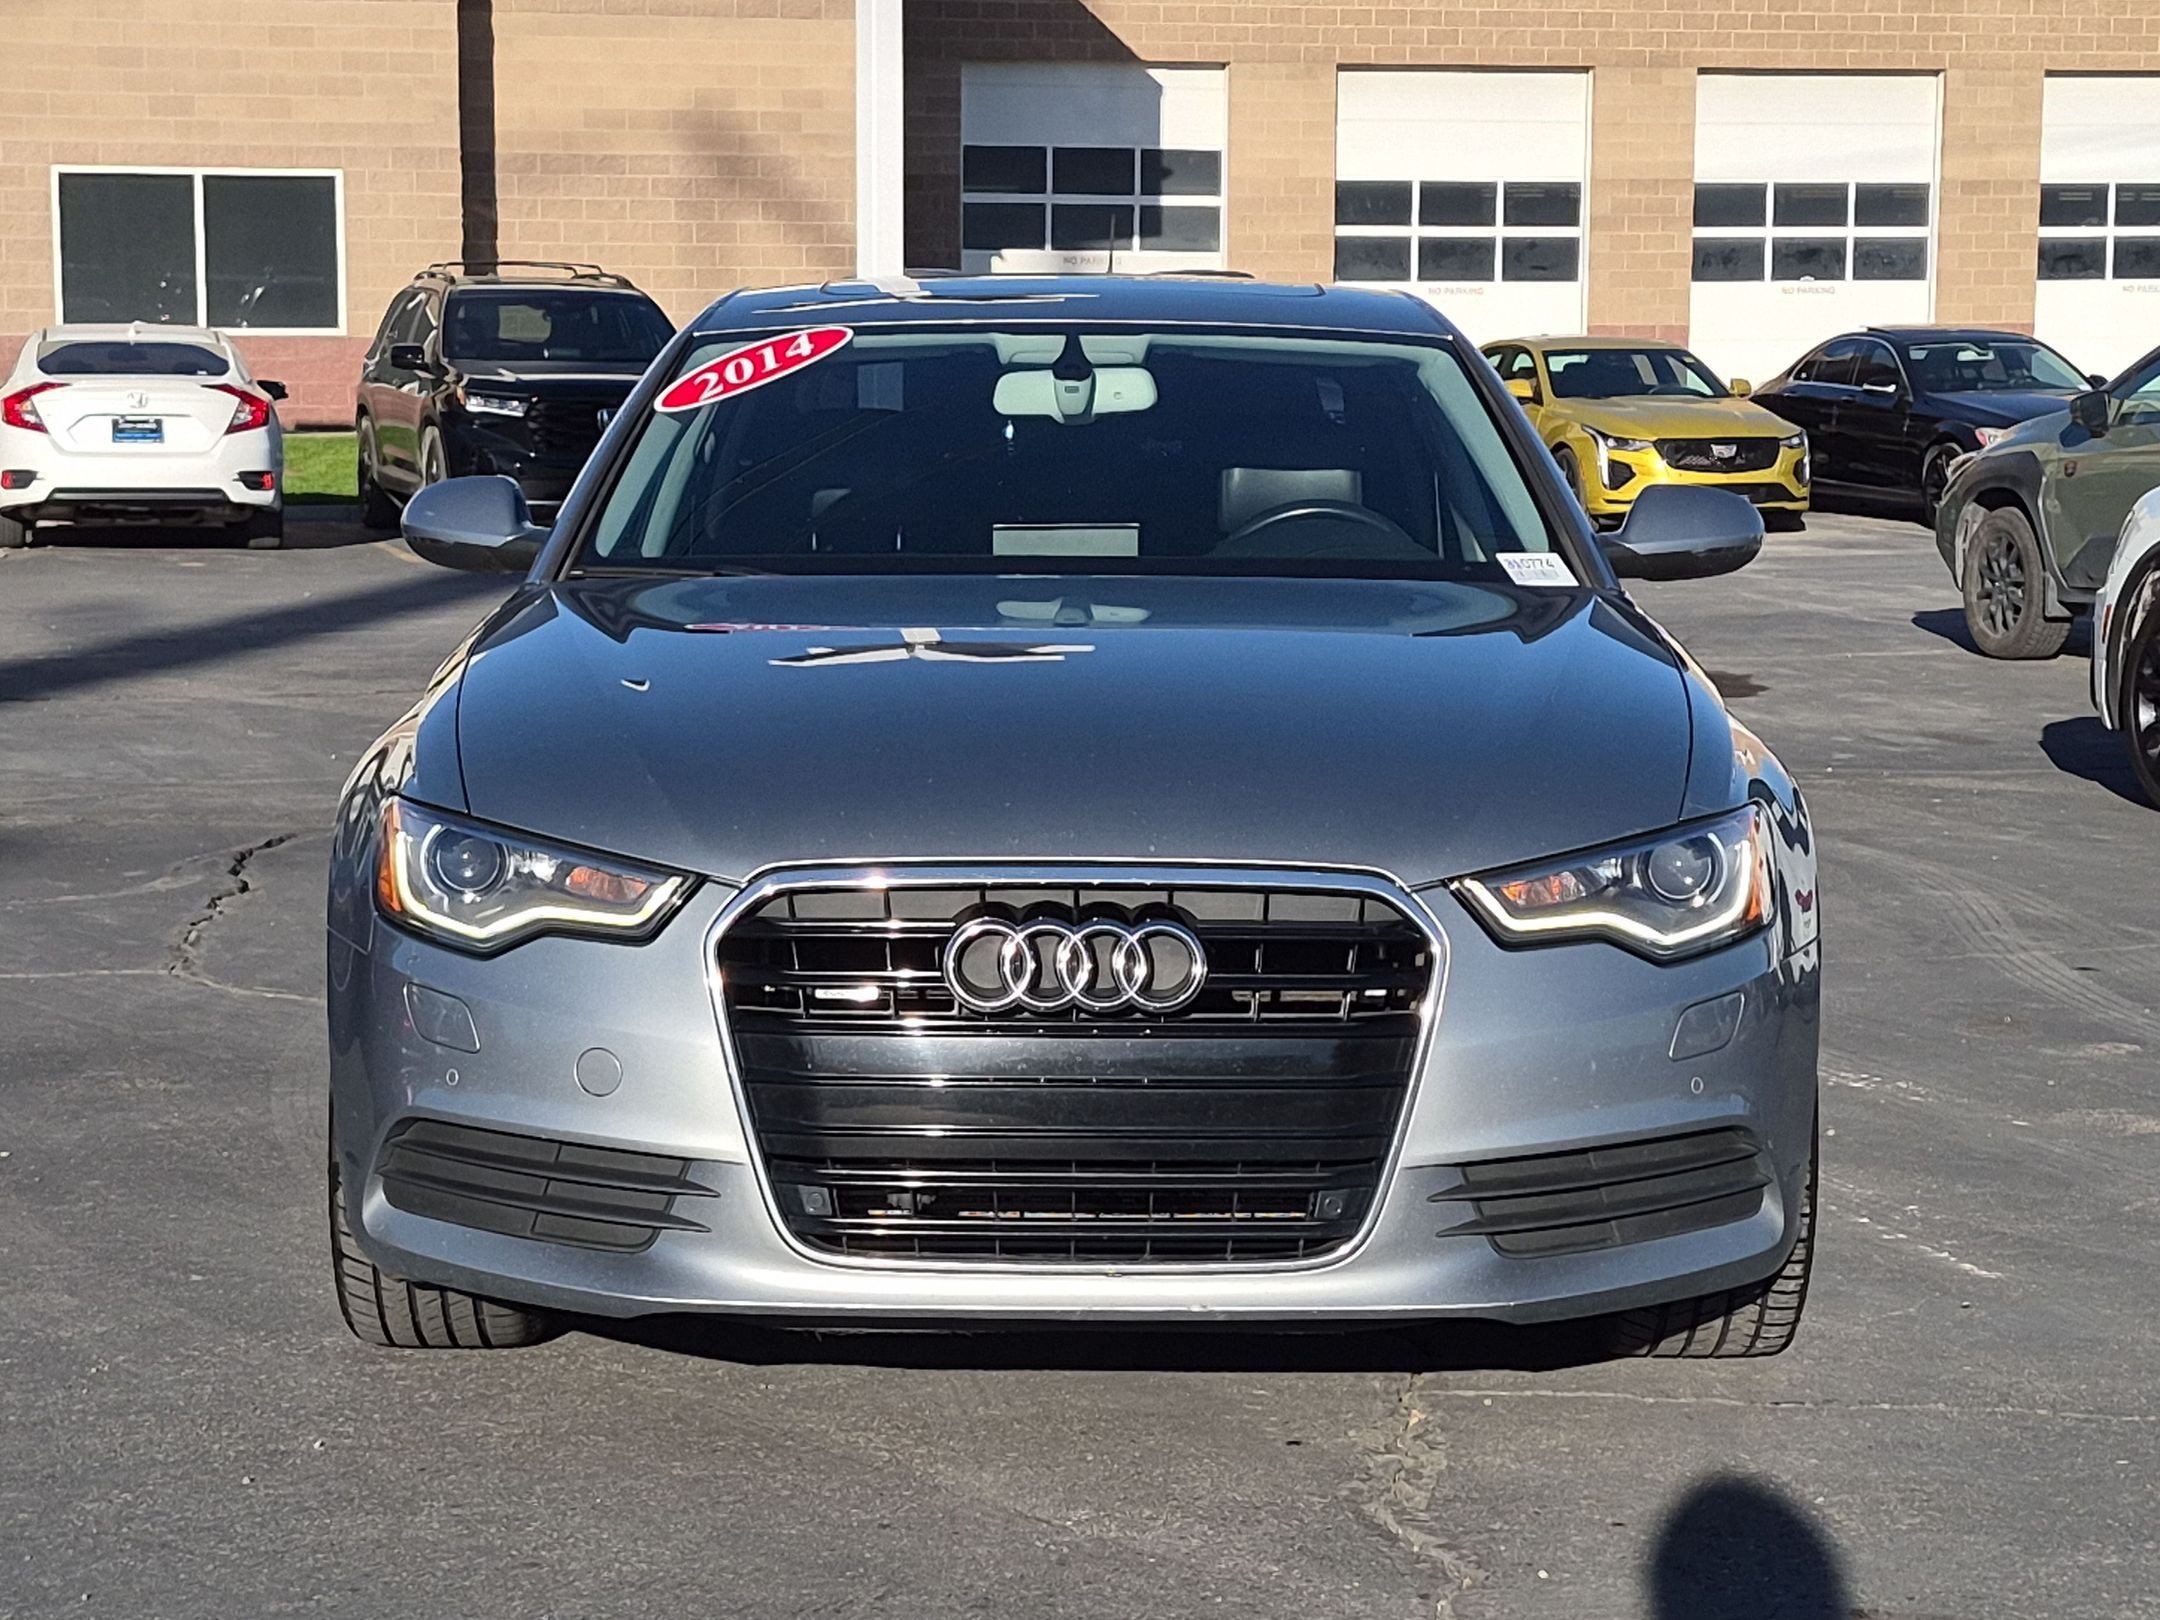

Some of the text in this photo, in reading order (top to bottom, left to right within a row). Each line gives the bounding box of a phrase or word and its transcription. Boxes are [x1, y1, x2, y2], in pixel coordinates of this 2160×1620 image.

[1063, 256, 1078, 265] NO
[1428, 287, 1485, 295] NO PARKING
[693, 333, 815, 402] 2014
